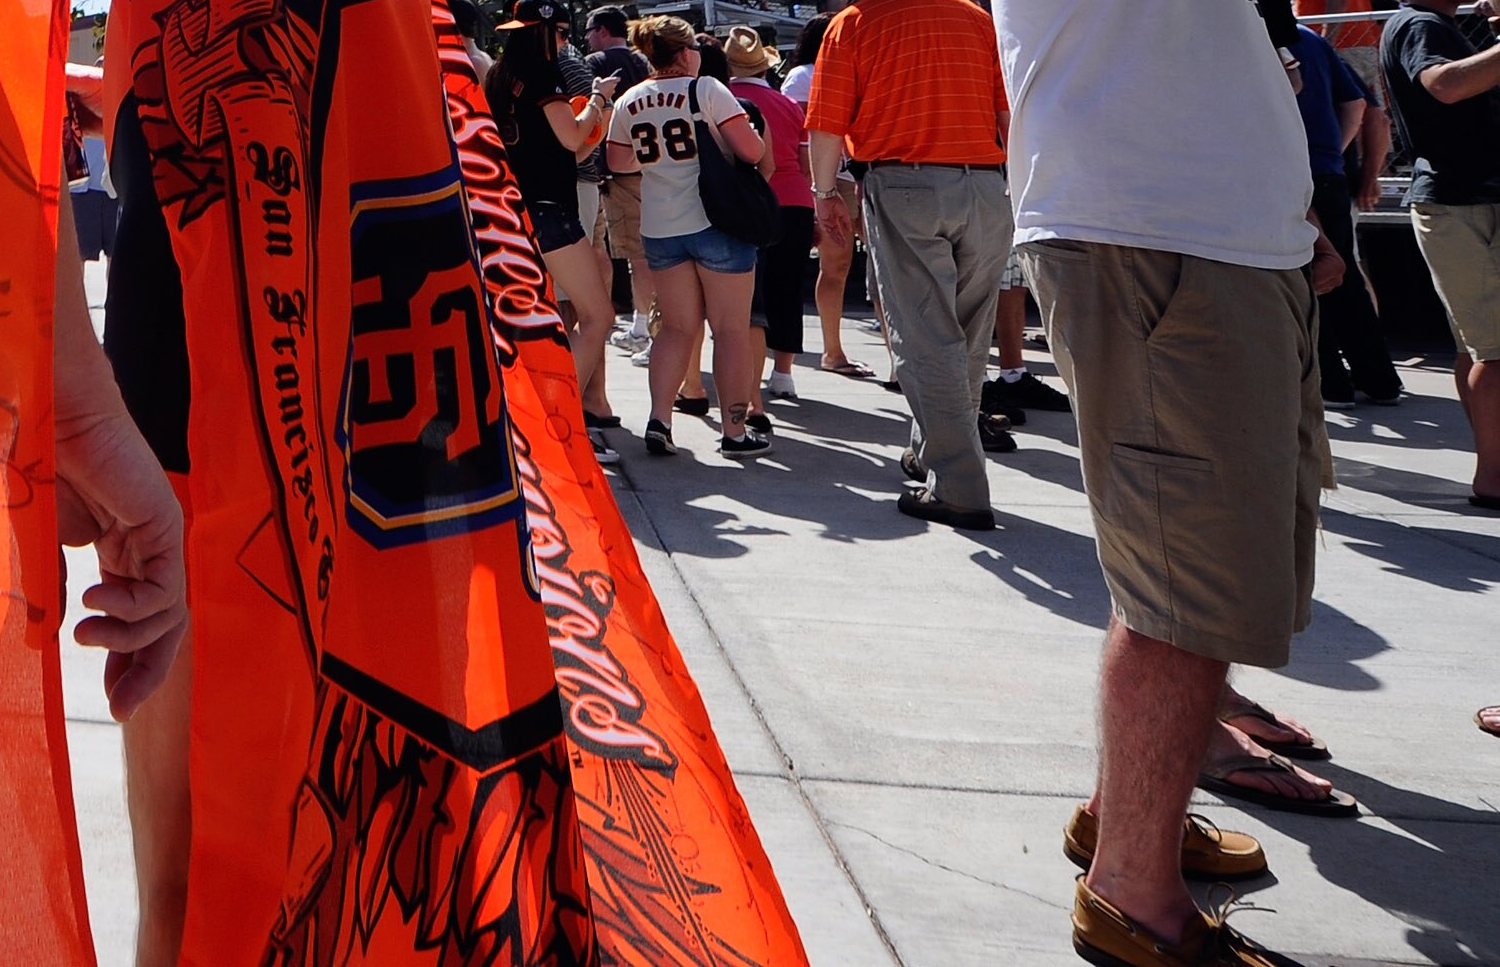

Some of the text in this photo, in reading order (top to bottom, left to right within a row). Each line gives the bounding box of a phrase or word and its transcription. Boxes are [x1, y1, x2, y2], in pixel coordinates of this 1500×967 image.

[626, 91, 687, 117] WILSON
[629, 117, 697, 165] 38
[245, 140, 301, 258] San
